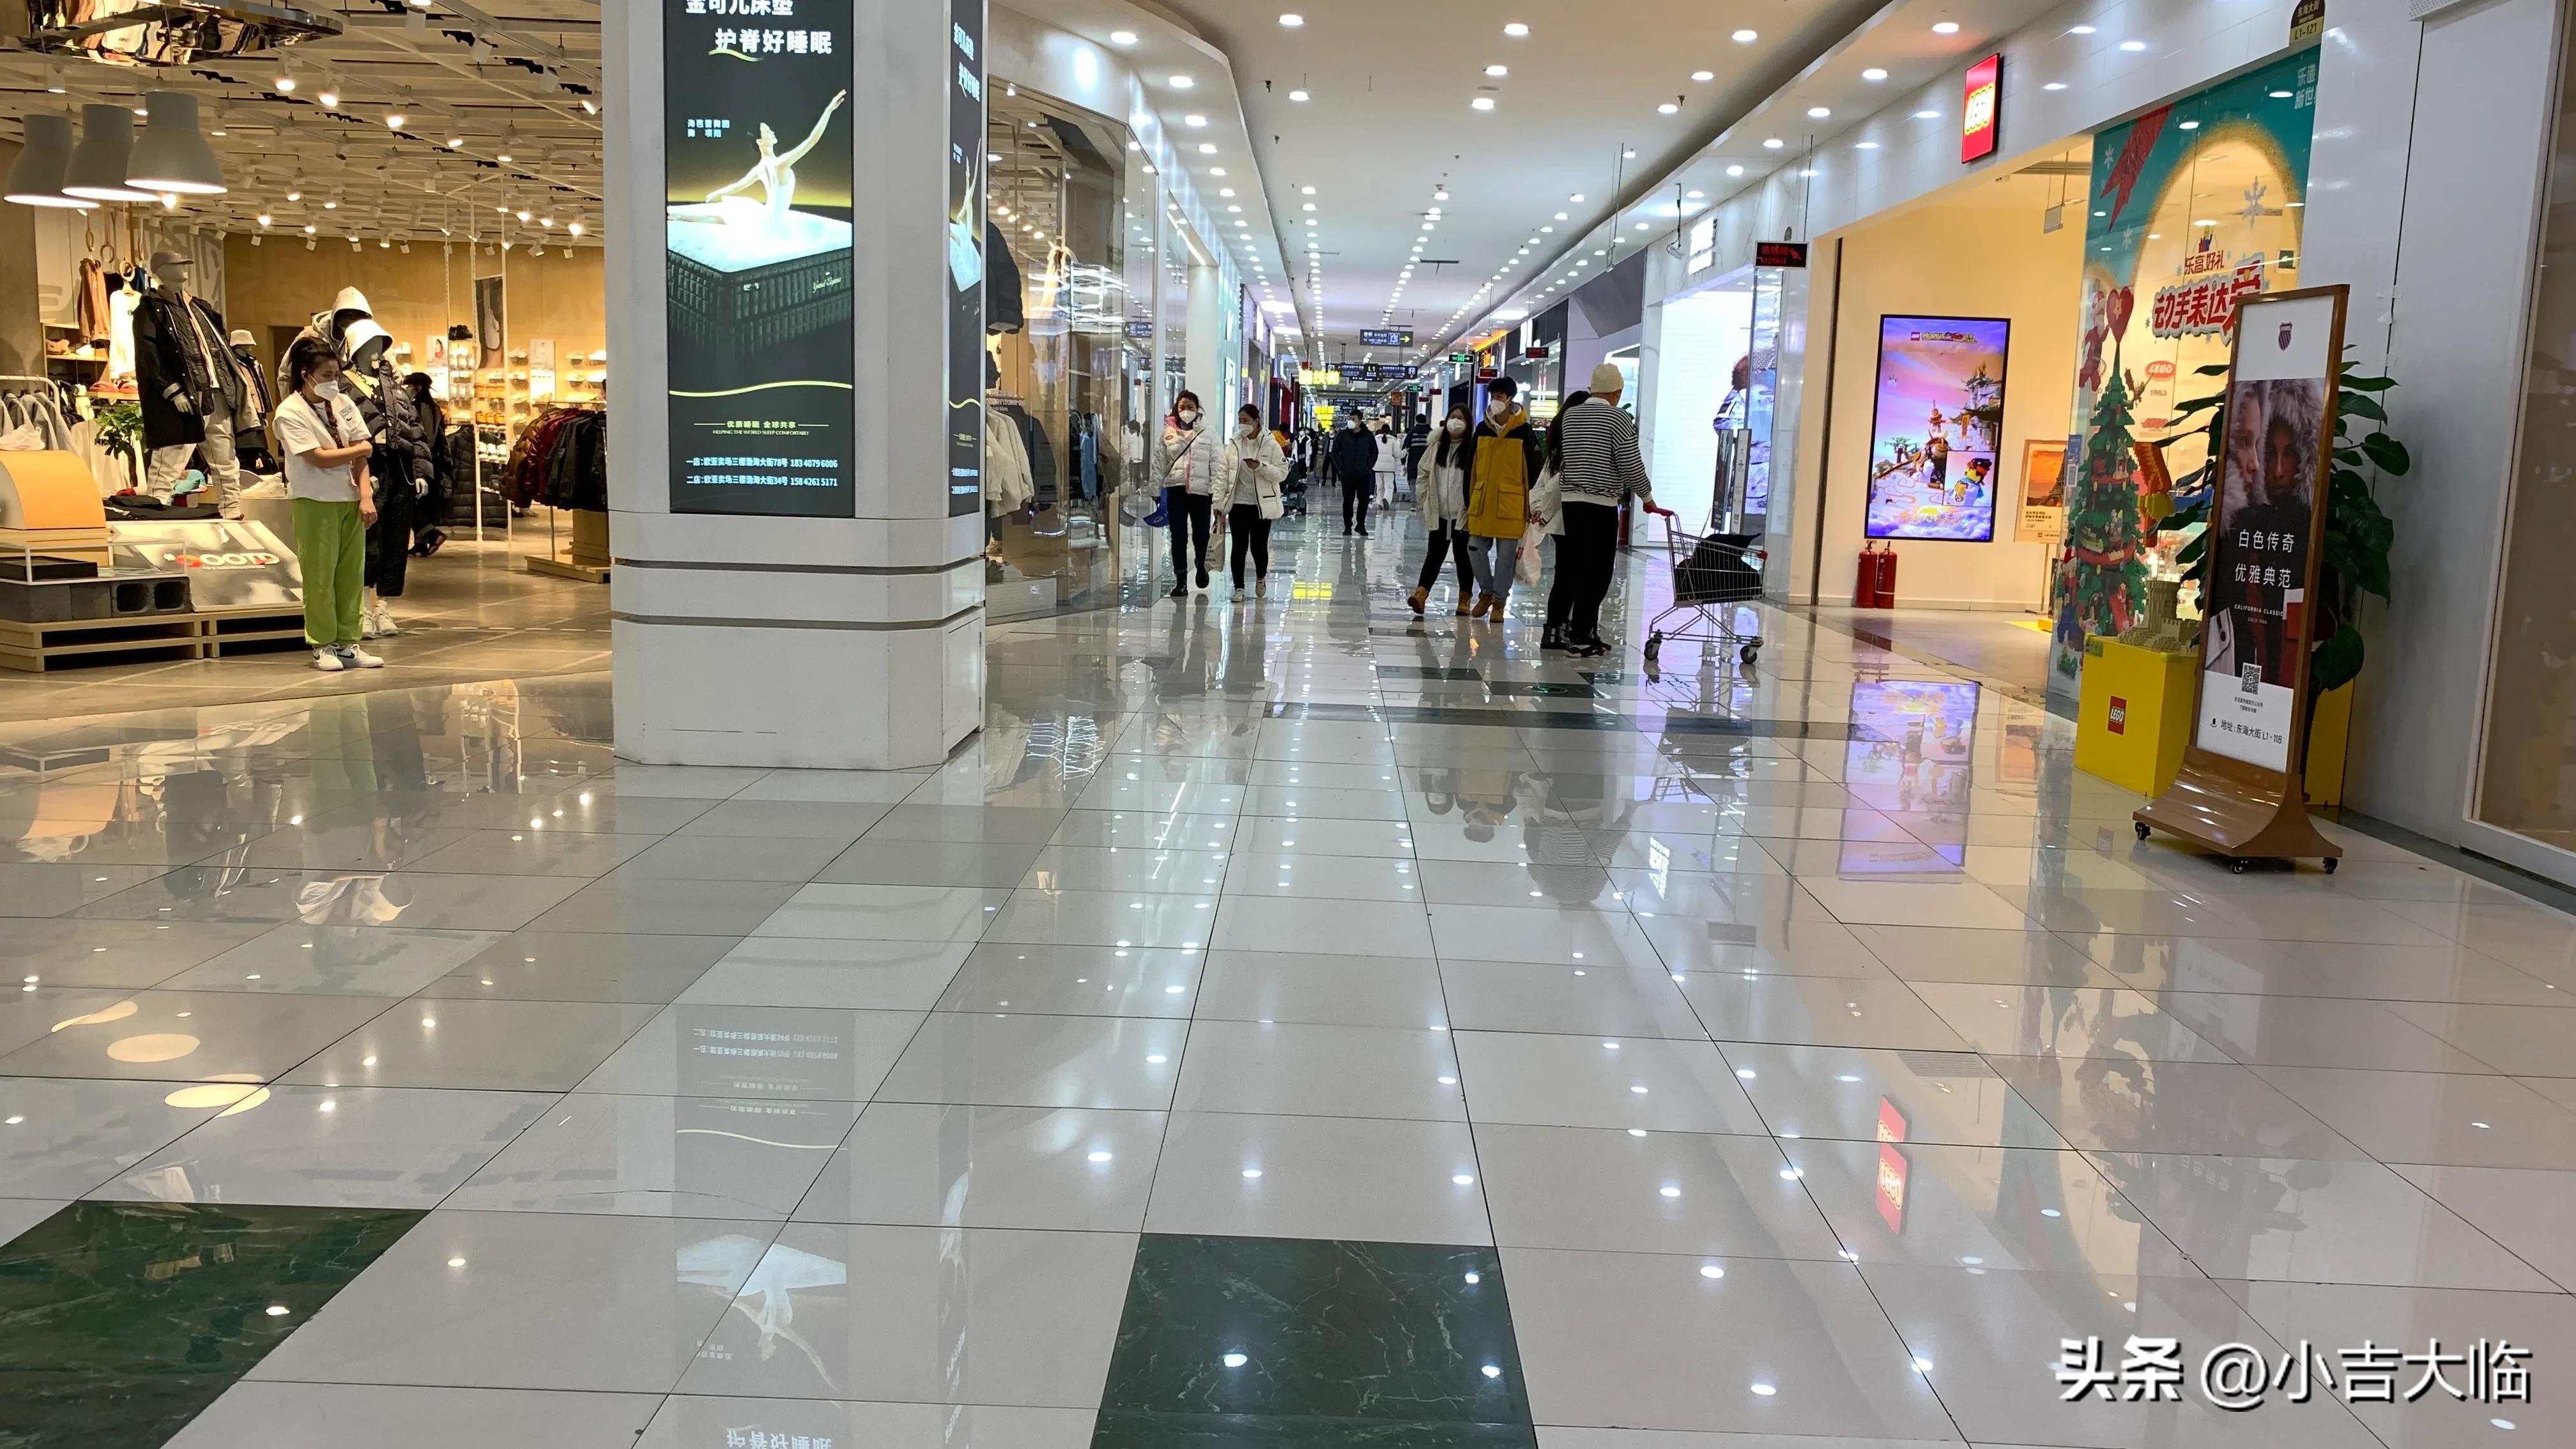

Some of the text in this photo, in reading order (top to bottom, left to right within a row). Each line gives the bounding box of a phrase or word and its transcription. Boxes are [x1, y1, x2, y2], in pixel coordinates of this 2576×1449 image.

[686, 0, 793, 15] 金可儿床垫
[715, 27, 832, 54] 护脊好睡眠
[2295, 22, 2317, 40] L1-121
[2294, 84, 2317, 109] 新世
[2184, 250, 2225, 275] 乐高好礼
[2239, 529, 2294, 553] 白色传奇
[2235, 563, 2292, 588] 优雅典范
[2234, 604, 2283, 617] CALIFORNIA CLASSIC
[2110, 708, 2124, 723] LEGO
